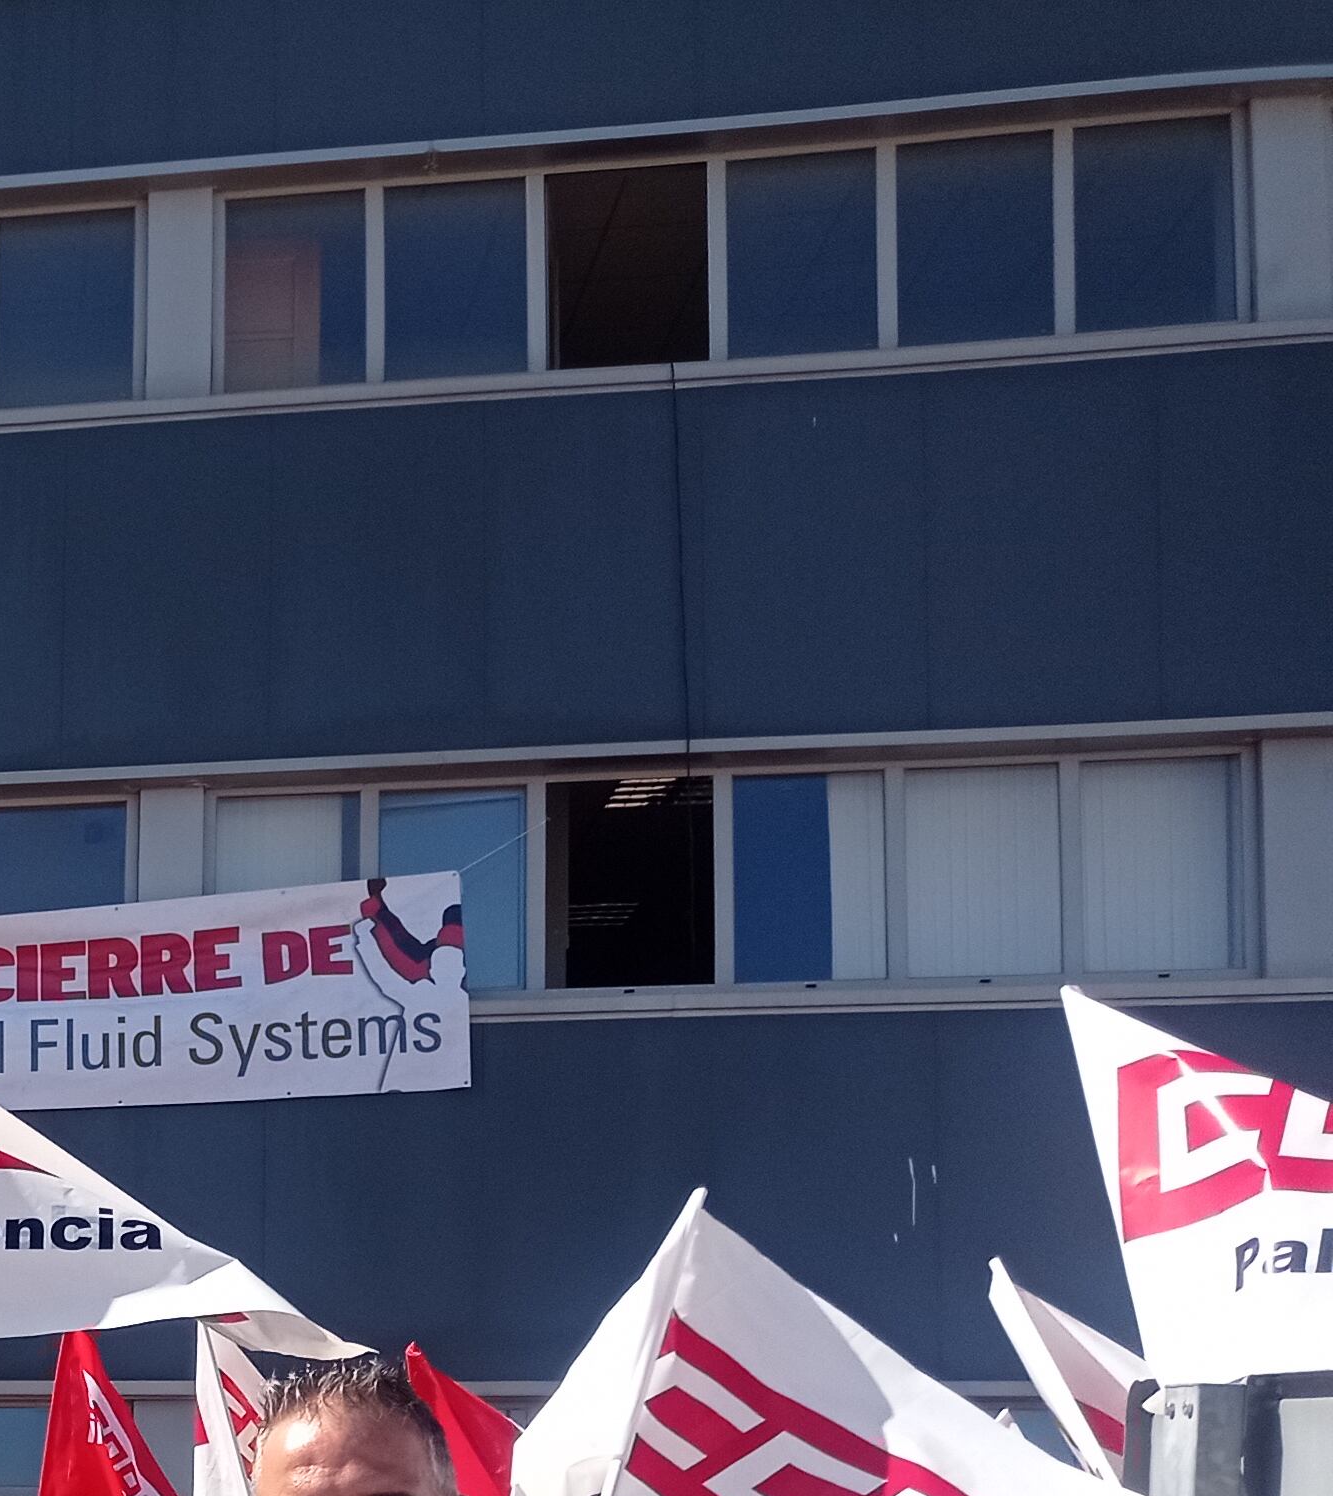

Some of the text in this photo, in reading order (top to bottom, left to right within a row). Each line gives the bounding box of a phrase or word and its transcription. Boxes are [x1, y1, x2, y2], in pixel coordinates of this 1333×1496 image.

[260, 923, 355, 985] DE
[30, 1014, 163, 1073] Fluid
[188, 1010, 443, 1078] Systems
